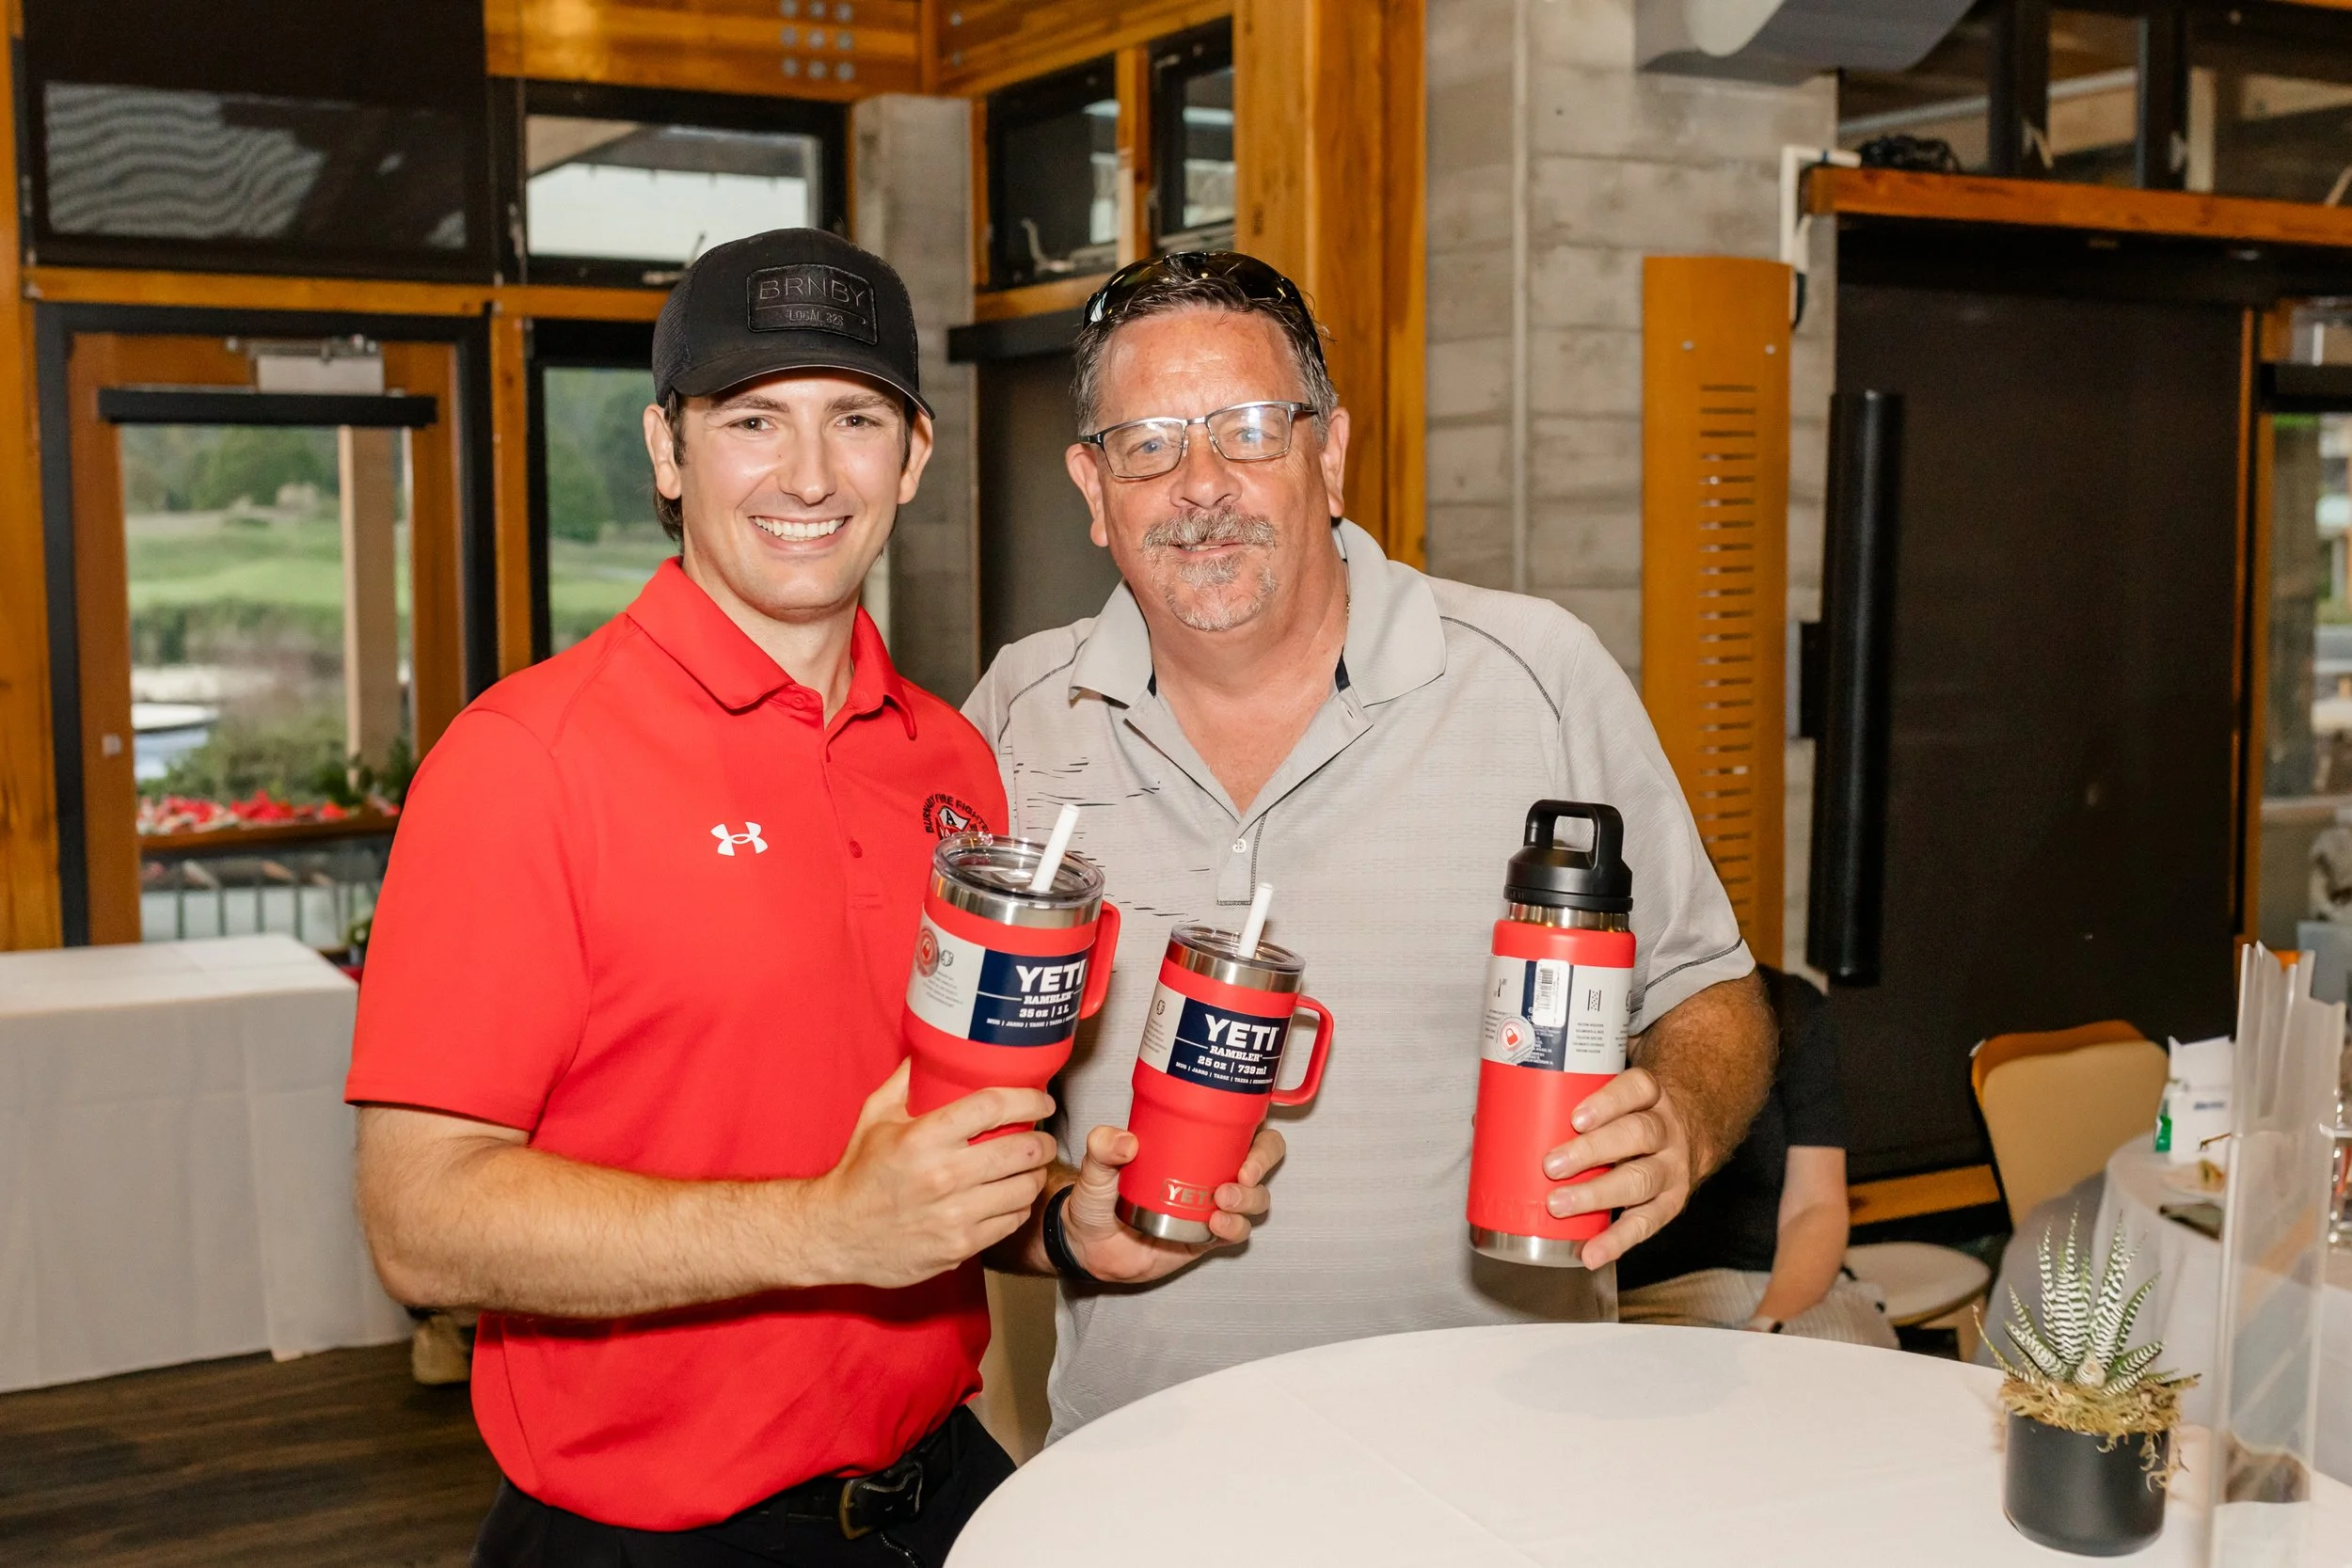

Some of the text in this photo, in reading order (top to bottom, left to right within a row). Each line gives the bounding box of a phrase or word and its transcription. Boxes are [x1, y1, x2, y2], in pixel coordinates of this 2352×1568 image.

[759, 277, 865, 307] BRNBY
[956, 799, 991, 834] FIGHTE
[1016, 958, 1087, 993] YETI
[1024, 990, 1073, 1005] RAMBLER
[1019, 1008, 1035, 1018] 35
[1205, 1014, 1278, 1052] YETI
[1198, 1055, 1212, 1067] 25
[1210, 1045, 1261, 1062] RAMBLER
